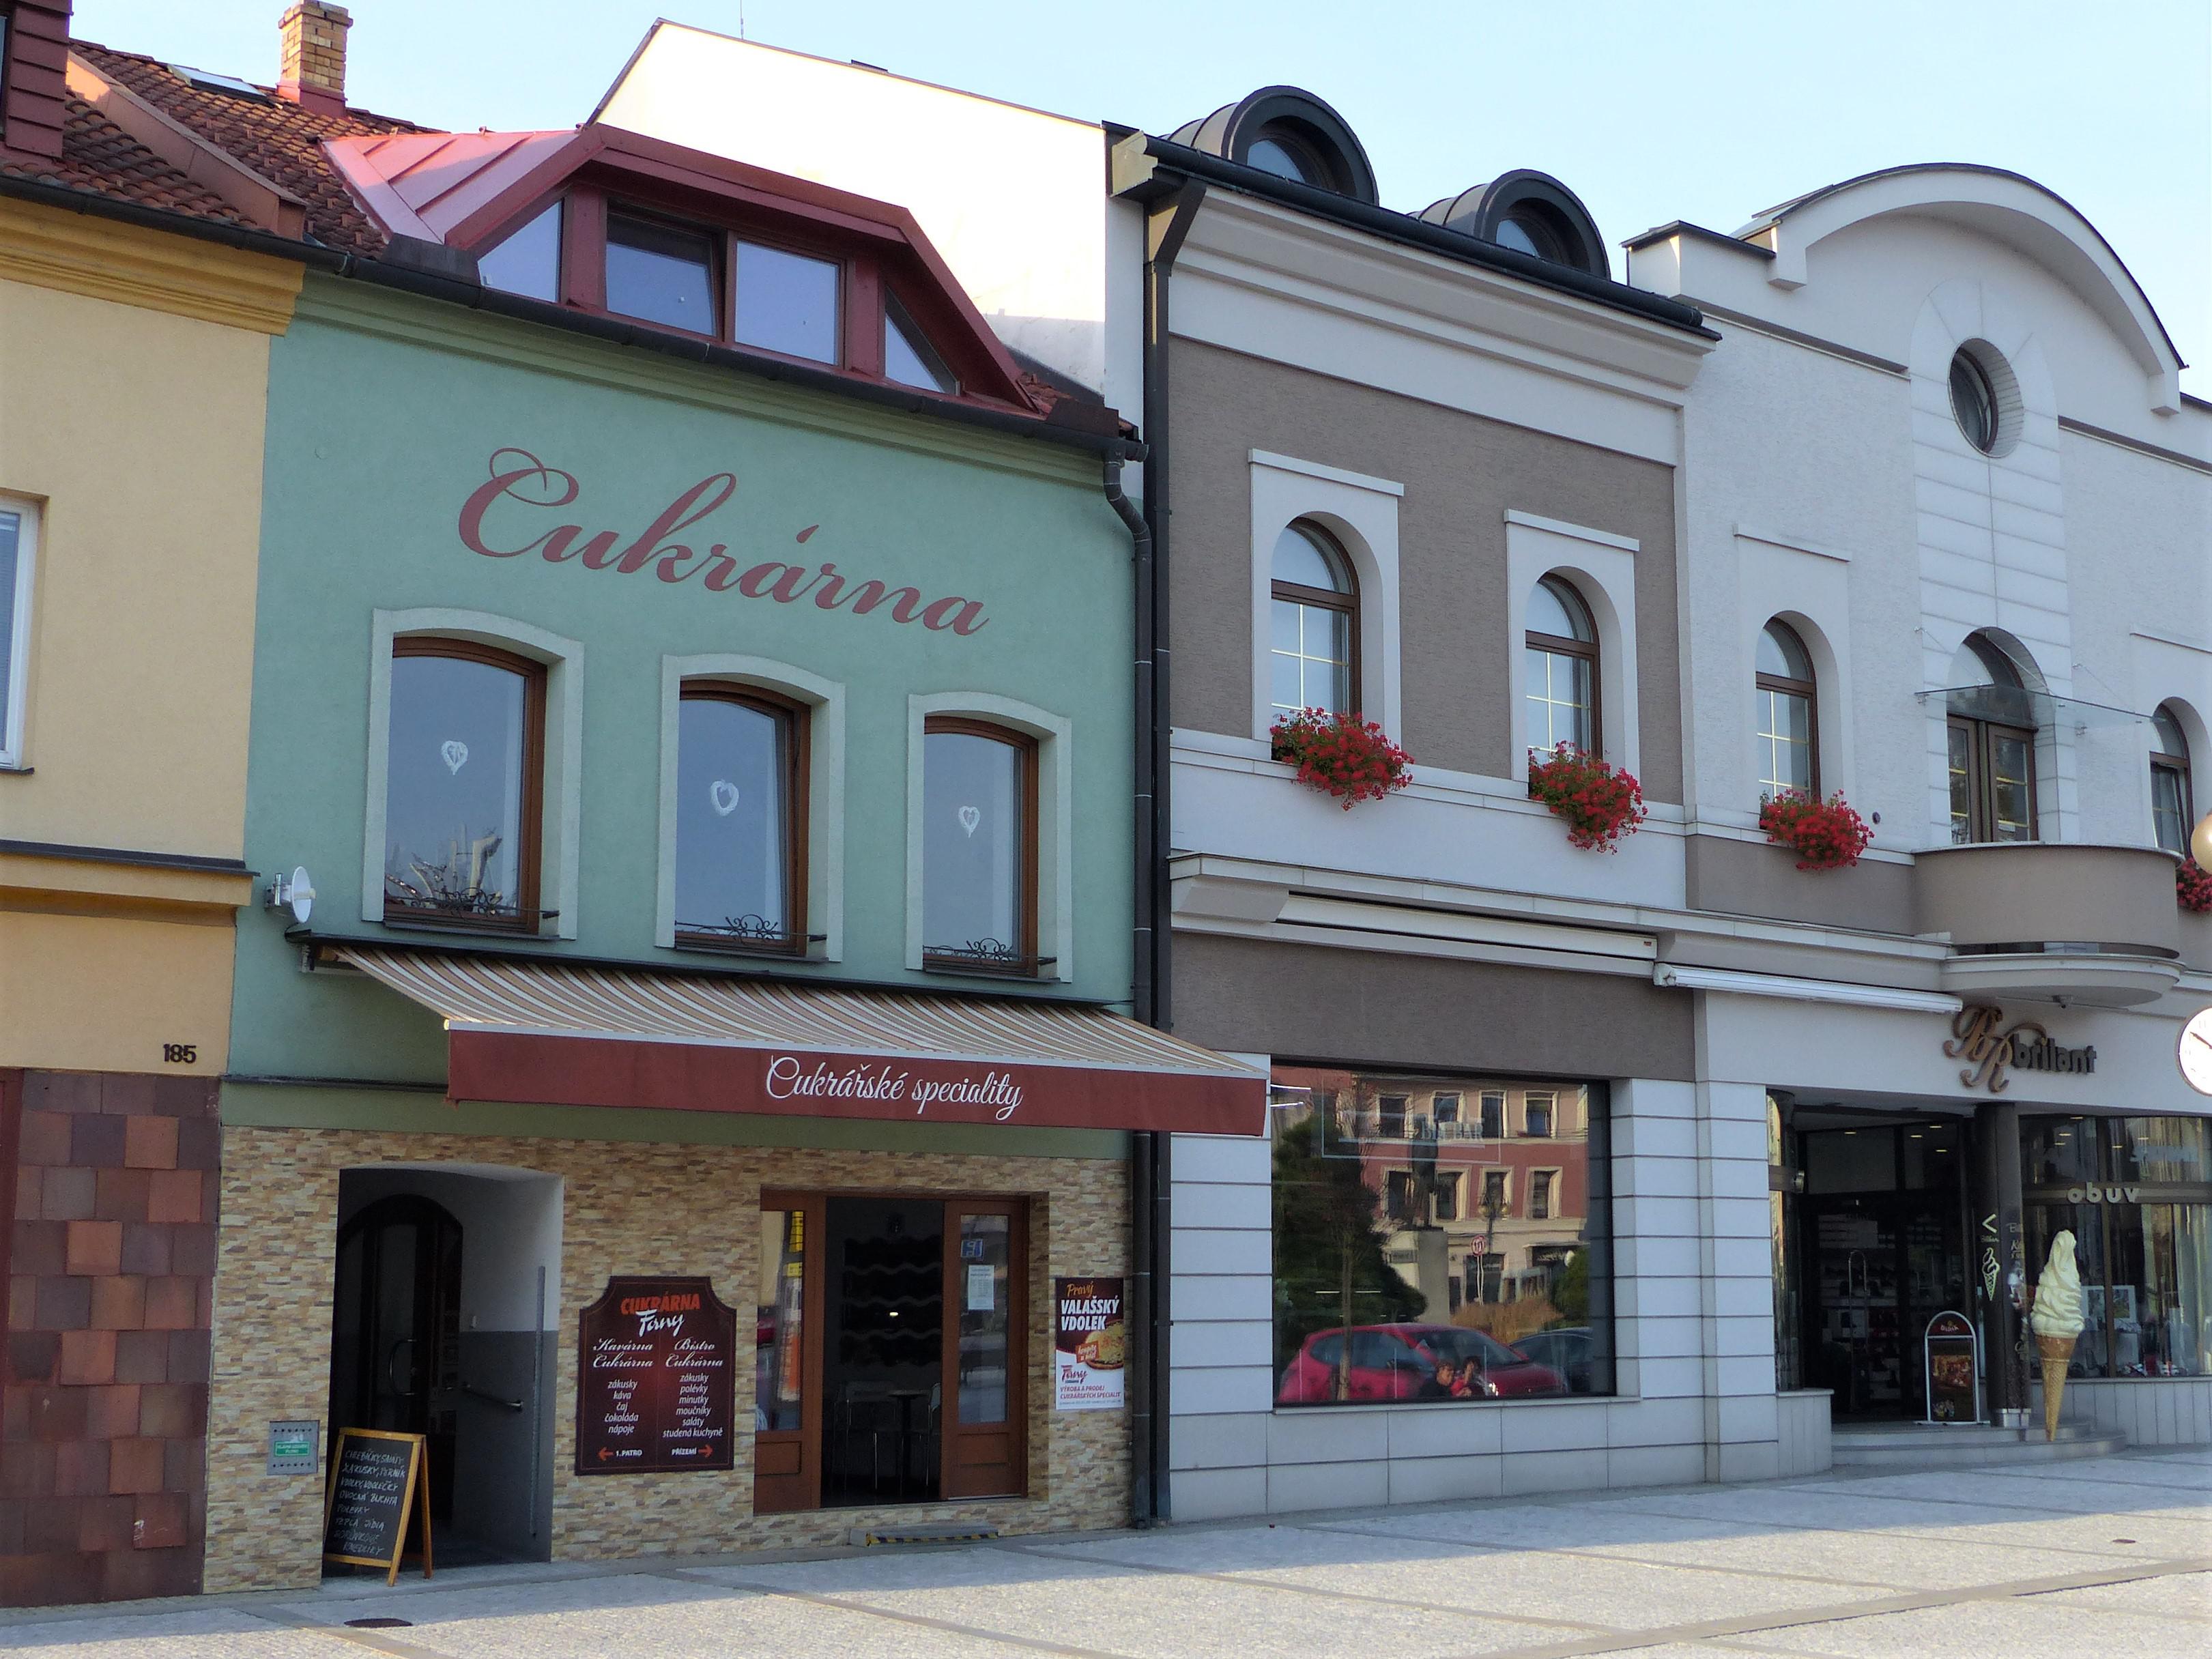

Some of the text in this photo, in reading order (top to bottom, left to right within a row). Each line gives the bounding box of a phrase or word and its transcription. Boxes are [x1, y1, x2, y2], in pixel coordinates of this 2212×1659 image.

[457, 447, 990, 636] Cukrárna
[163, 1043, 197, 1063] 185
[2013, 1033, 2097, 1073] brilant
[766, 1055, 1023, 1121] Cukrářské speciality
[2067, 1181, 2140, 1203] obuv
[1067, 1281, 1093, 1298] Pravý
[620, 1291, 701, 1315] CUKRÁRNA
[1061, 1295, 1119, 1314] VALAŠSKÝ
[1061, 1316, 1106, 1331] VDOLEK
[592, 1338, 653, 1351] Kavárna
[674, 1336, 715, 1351] Bistro
[592, 1351, 654, 1368] Cukrárna
[665, 1351, 723, 1368] Cukrárna
[607, 1379, 637, 1390] zákusky
[680, 1372, 709, 1383] zákusky
[613, 1390, 632, 1399] káva
[680, 1383, 708, 1394] polévky
[679, 1395, 709, 1405] minutky
[616, 1402, 628, 1413] čaj
[676, 1405, 712, 1417] moučníky
[605, 1412, 639, 1422] čokoláda
[683, 1416, 704, 1428] saláty
[608, 1424, 635, 1436] nápoje
[662, 1428, 691, 1439] studená
